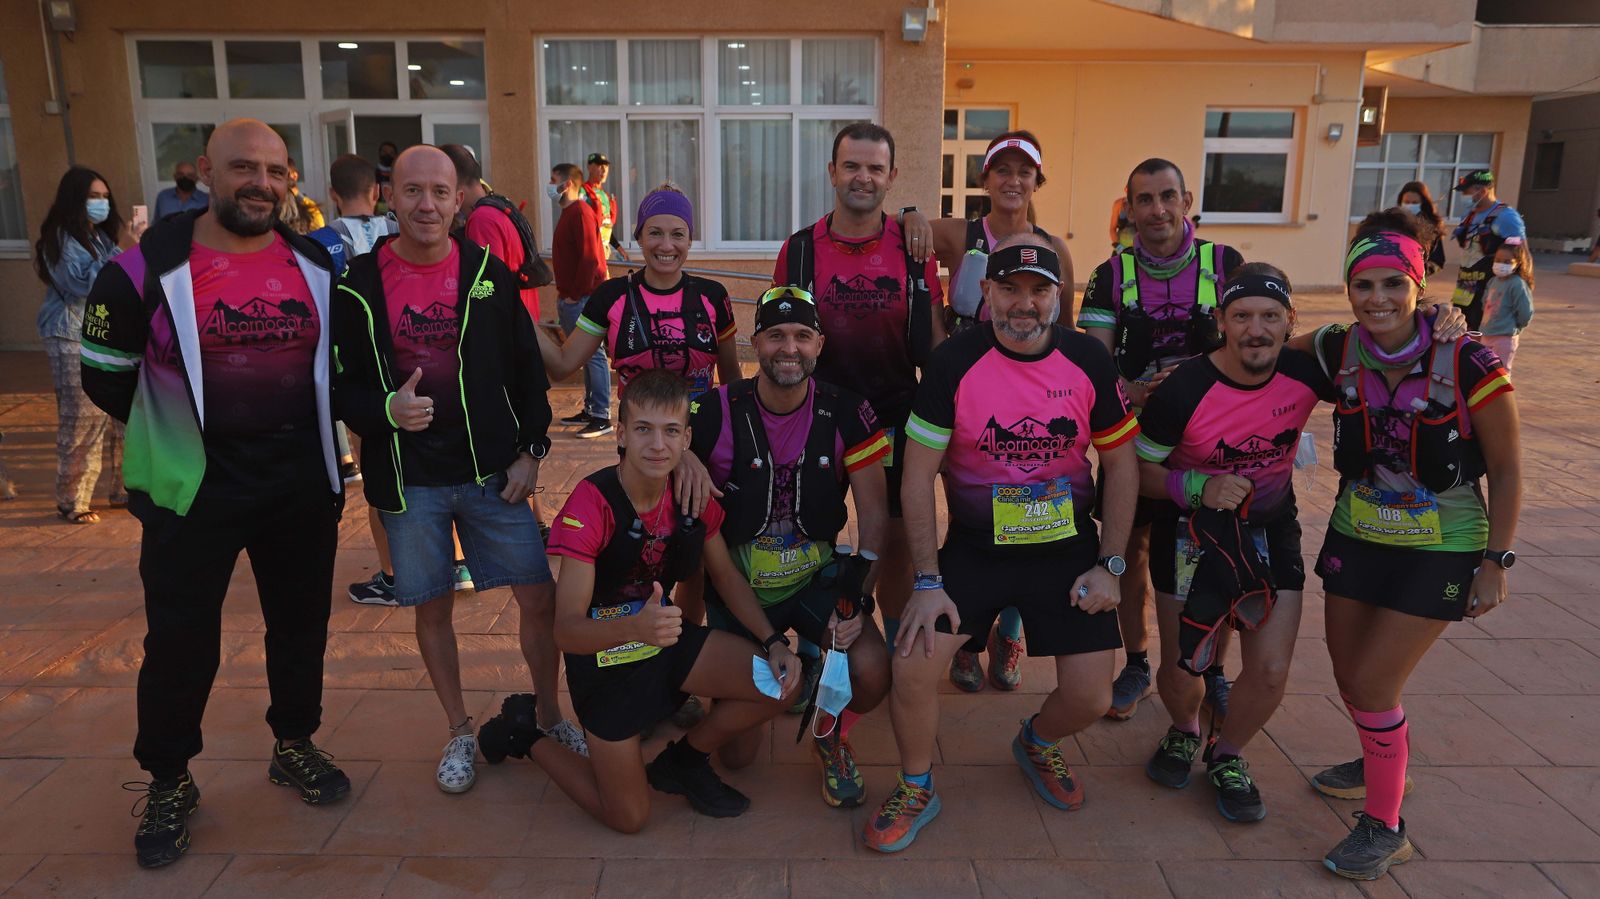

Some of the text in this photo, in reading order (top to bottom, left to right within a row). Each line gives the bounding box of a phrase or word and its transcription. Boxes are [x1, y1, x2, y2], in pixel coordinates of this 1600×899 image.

[87, 323, 110, 341] Eric
[1046, 389, 1072, 399] GOBIK
[989, 451, 1065, 462] TRAIL
[1024, 502, 1049, 518] 242
[1376, 507, 1402, 522] 108
[779, 549, 797, 564] 172
